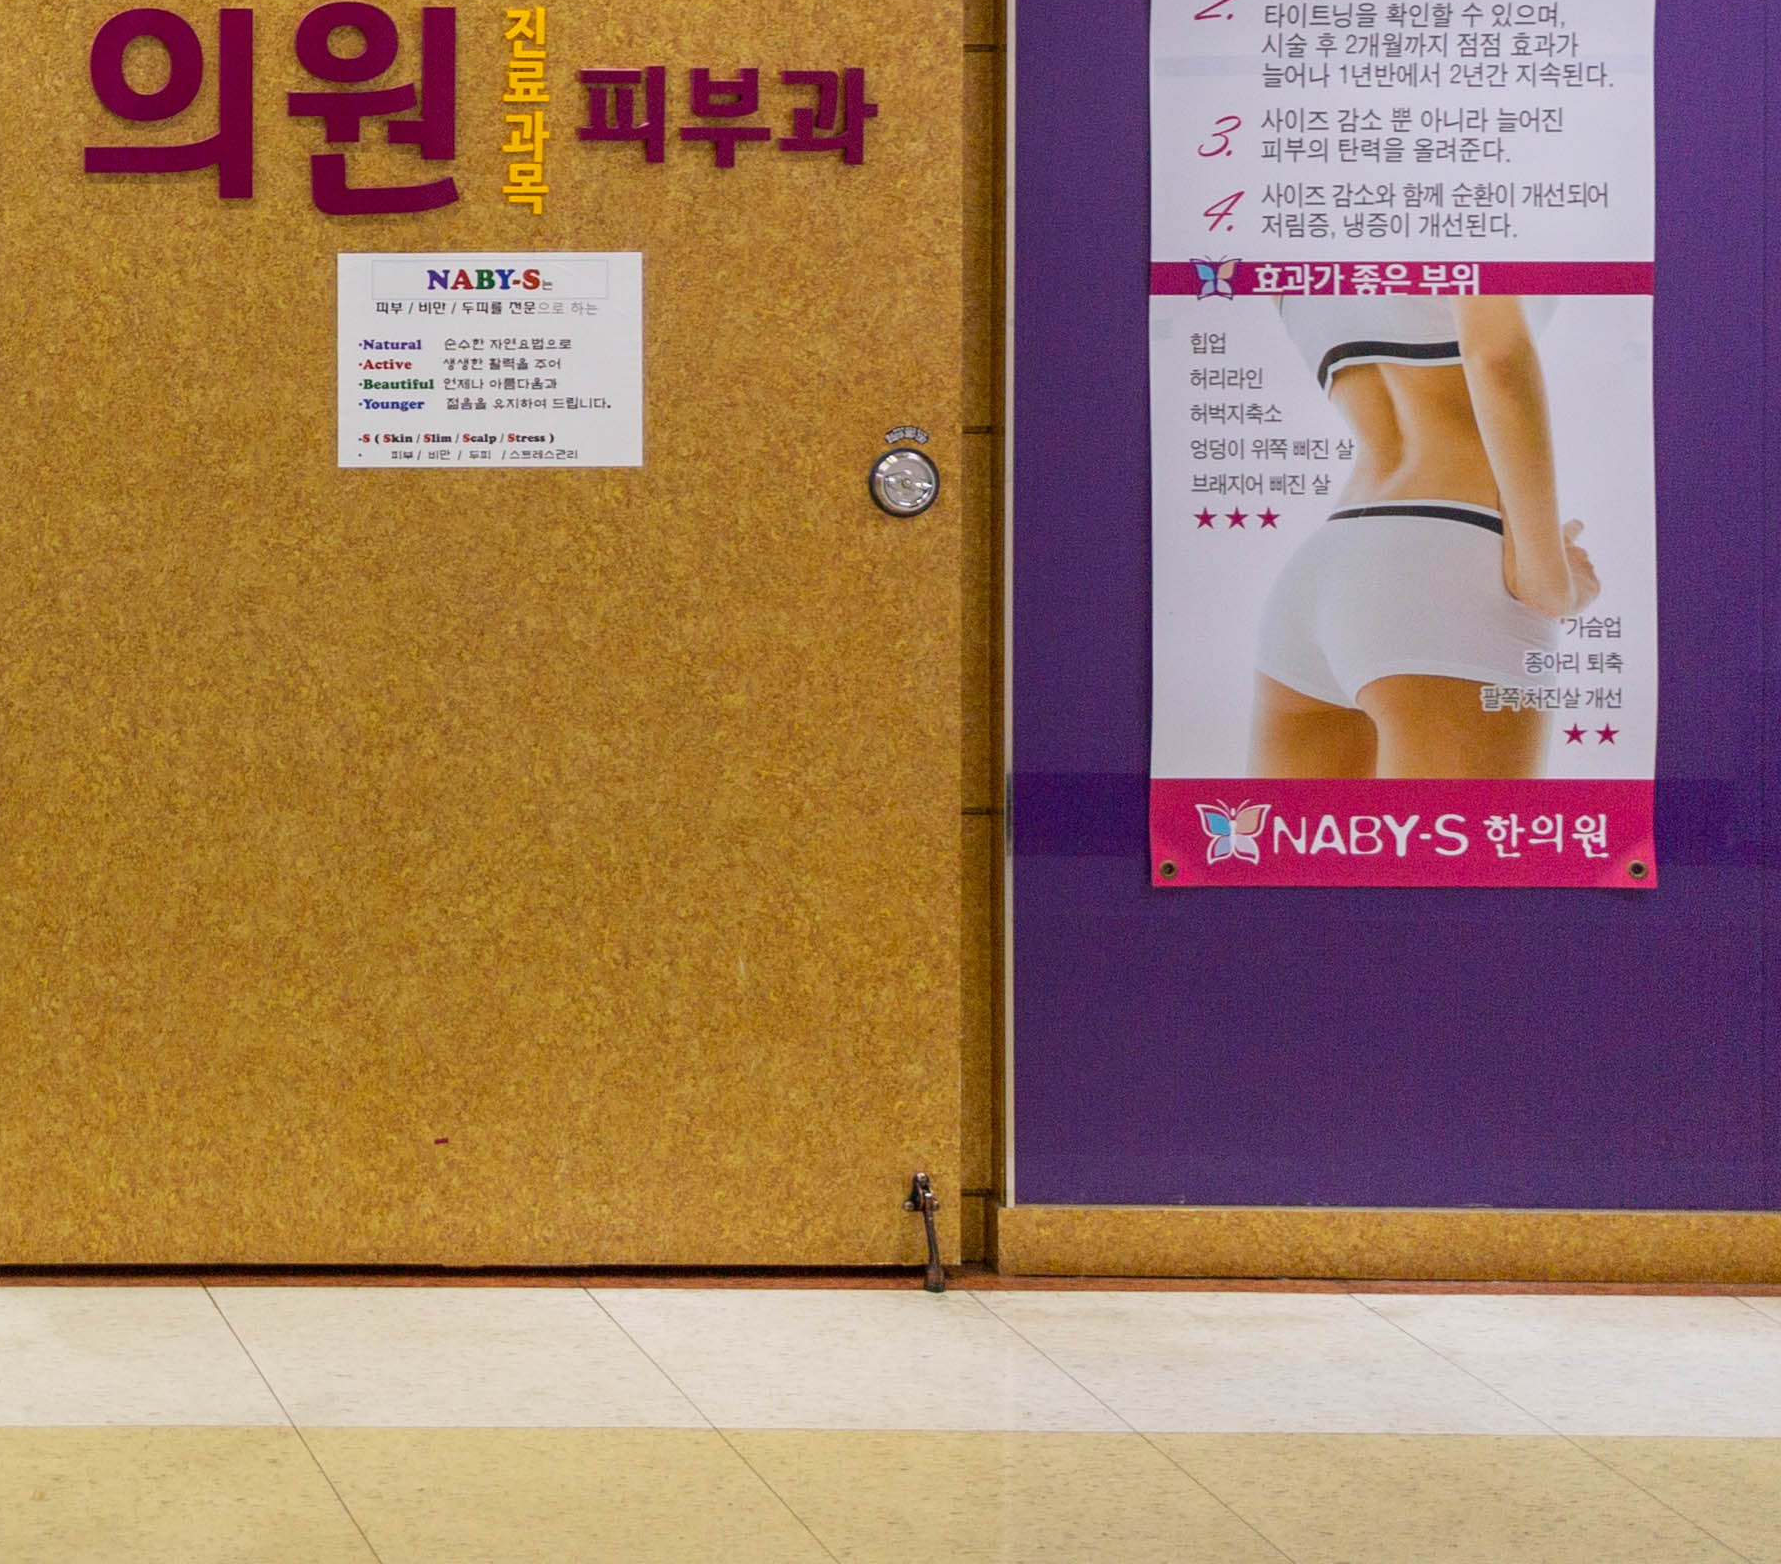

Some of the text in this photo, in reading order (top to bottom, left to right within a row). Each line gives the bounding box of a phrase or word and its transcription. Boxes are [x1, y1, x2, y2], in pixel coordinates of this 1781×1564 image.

[1264, 2, 1565, 29] 타이트닝을 확인할 수 있으며,
[1262, 33, 1578, 58] 시술 후 2개월까지 점점 효과가
[84, 0, 459, 216] 의원
[502, 6, 549, 214] 진료과목
[577, 65, 879, 168] 피부과
[1252, 264, 1480, 297] 효과가 좋은 부위
[376, 302, 402, 314] 피부
[419, 302, 446, 314] 비만
[462, 302, 502, 315] 두피를
[509, 302, 566, 315] 전문으로
[445, 338, 484, 350] 순수한
[490, 338, 572, 350] 자연요법으로
[1190, 334, 1226, 355] 힙업
[443, 358, 484, 370] 생생한
[489, 358, 529, 370] 활력을
[534, 358, 561, 370] 주어
[444, 378, 484, 390] 언제나
[490, 378, 557, 390] 아름다움과
[1190, 368, 1264, 390] 허리라인
[446, 398, 487, 410] 젊음을
[493, 398, 547, 409] 유지하여
[552, 398, 611, 409] 드립니다.
[1190, 403, 1282, 425] 허벅지축소
[383, 433, 545, 445] Skin Slim Scalp Stress
[1566, 617, 1621, 639] 가슴업
[1525, 653, 1579, 675] 종아리
[1273, 814, 1608, 859] NABY-S 한의원
